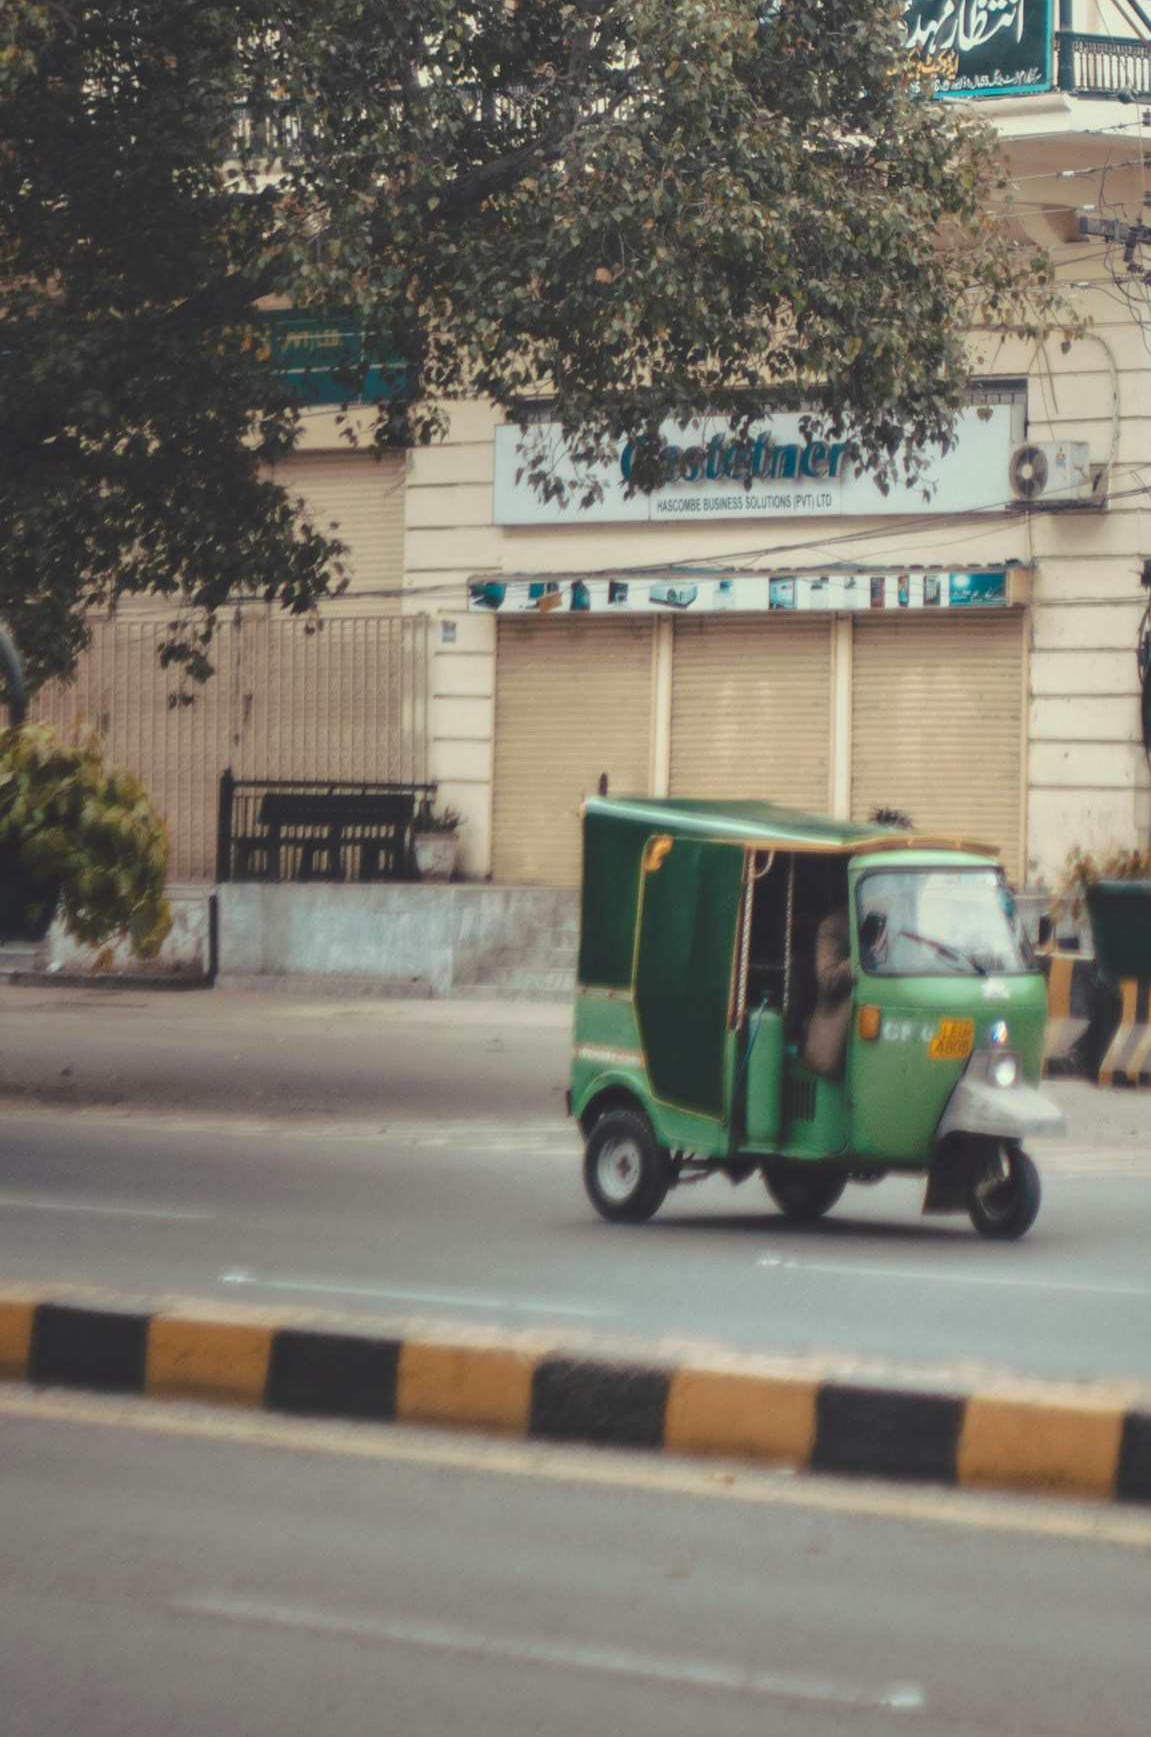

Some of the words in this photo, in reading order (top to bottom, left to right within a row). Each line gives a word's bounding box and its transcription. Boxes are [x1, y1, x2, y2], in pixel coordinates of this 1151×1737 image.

[656, 498, 701, 512] HASCOMBE
[703, 496, 743, 511] BUSINESS
[745, 495, 791, 510] SOLUTIONS
[793, 494, 815, 510] (PVT)
[816, 493, 832, 507] LTD
